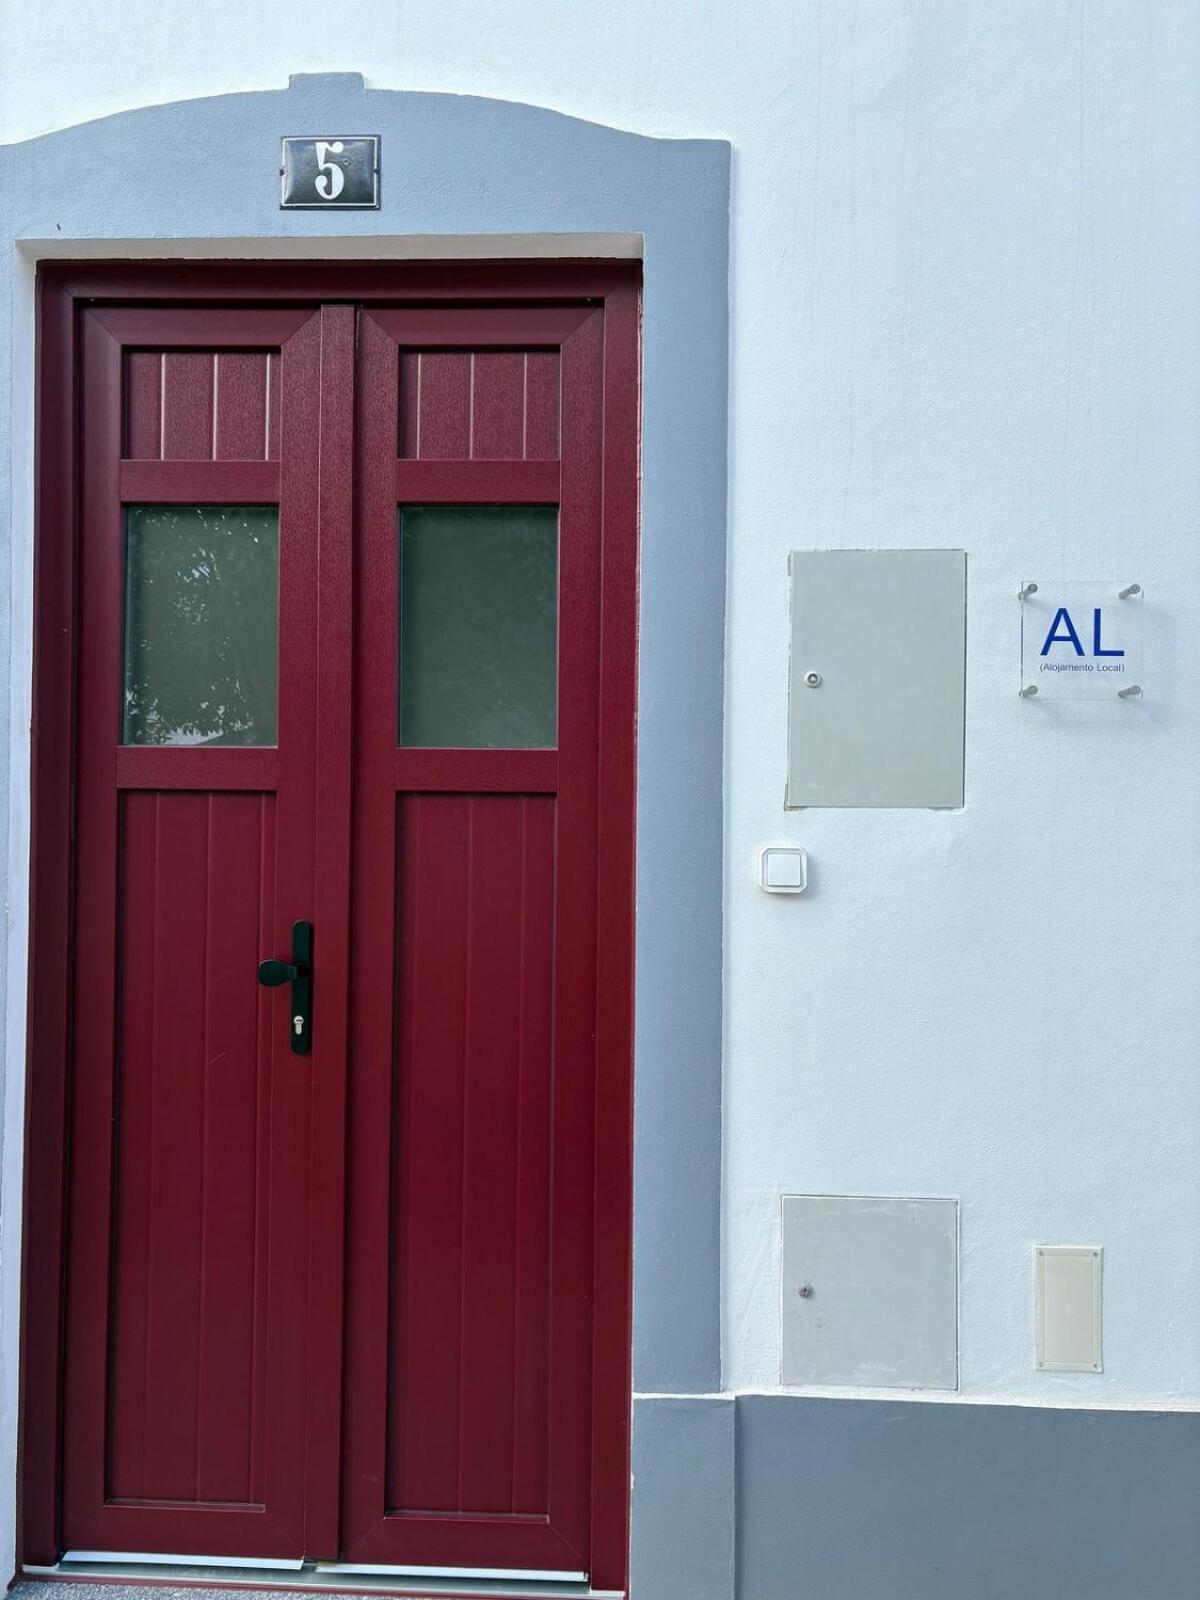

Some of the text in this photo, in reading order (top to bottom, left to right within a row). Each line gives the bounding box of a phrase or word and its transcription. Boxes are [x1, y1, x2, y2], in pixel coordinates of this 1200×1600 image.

[315, 141, 345, 200] 5
[1040, 607, 1125, 657] AL
[1039, 663, 1125, 673] (Alojamento Local)
